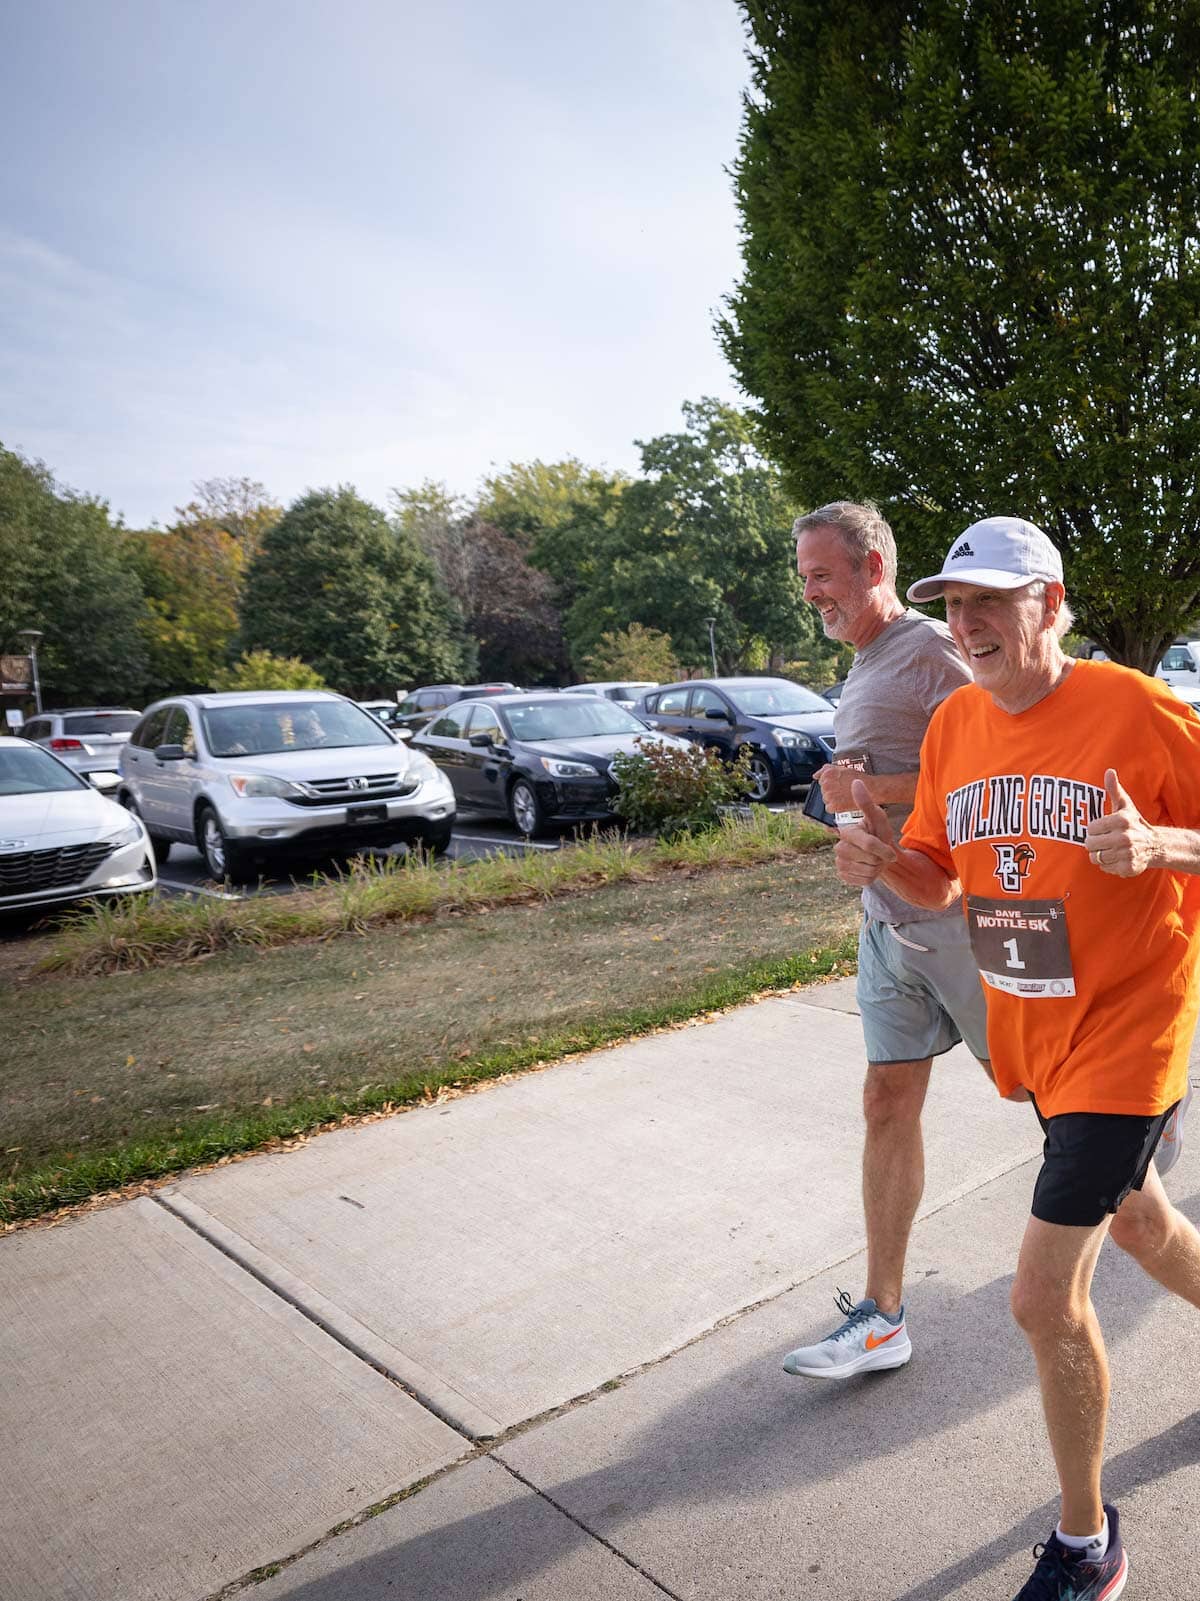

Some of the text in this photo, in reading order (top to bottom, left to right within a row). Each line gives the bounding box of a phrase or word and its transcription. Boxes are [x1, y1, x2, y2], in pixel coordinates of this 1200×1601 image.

[946, 774, 1106, 850] OWLING GREEN
[976, 915, 1051, 932] WOTTLE 5K
[995, 909, 1021, 918] DAVE
[1003, 938, 1026, 969] 1
